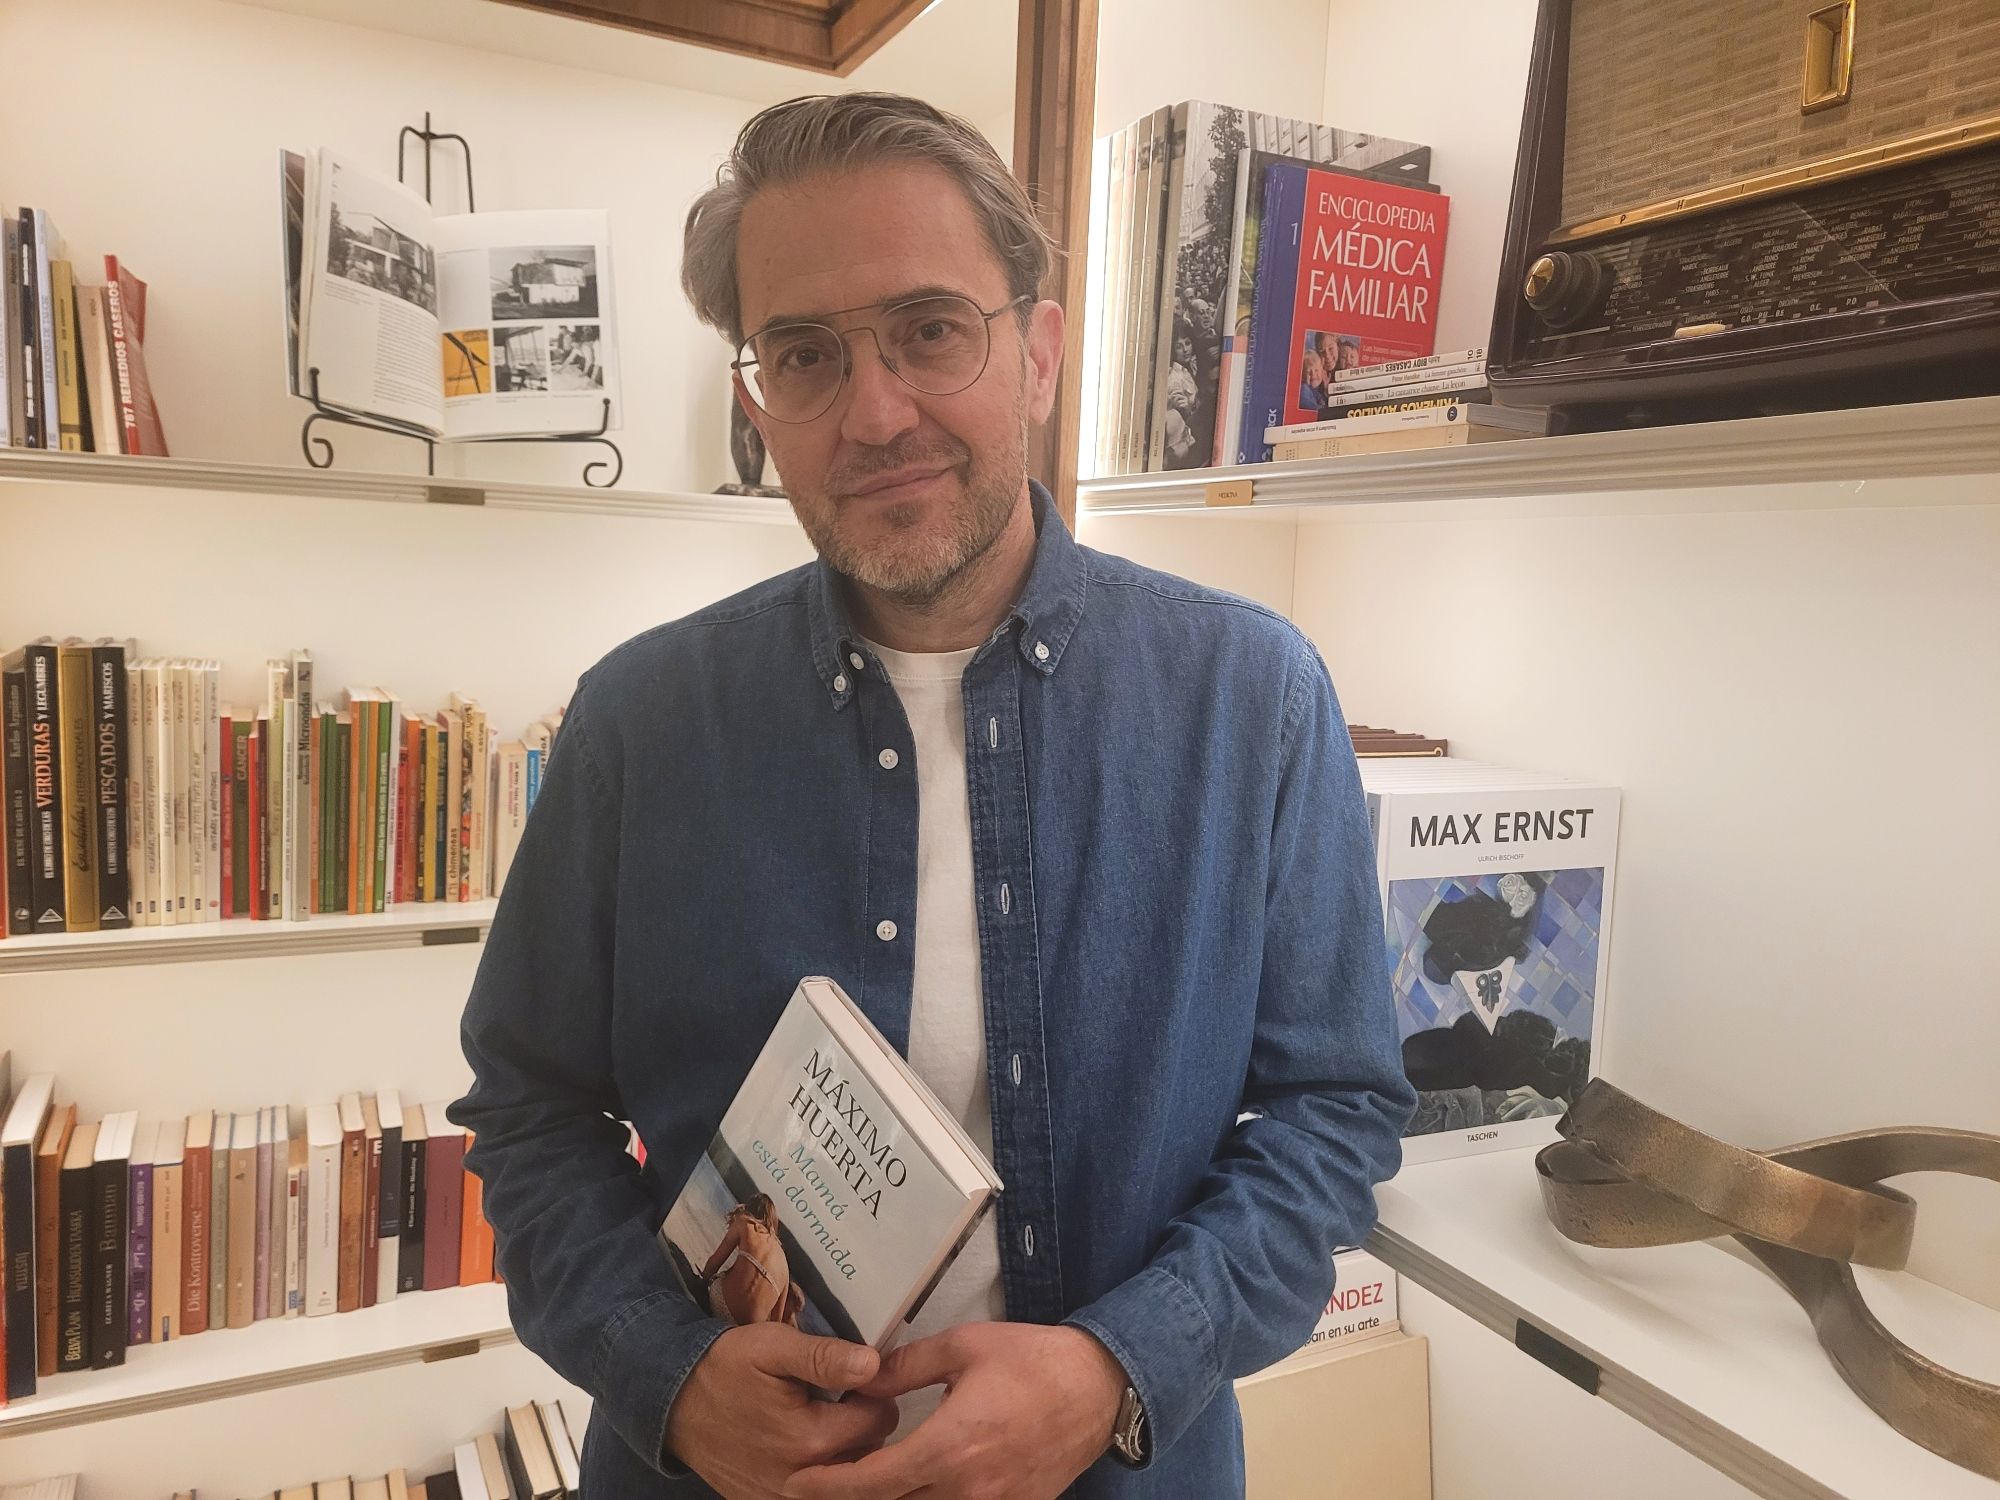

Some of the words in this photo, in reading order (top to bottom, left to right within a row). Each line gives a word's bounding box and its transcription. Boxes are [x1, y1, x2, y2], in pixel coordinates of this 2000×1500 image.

[1291, 222, 1298, 246] 1
[1319, 192, 1436, 234] ENCICLOPEDIA
[1312, 222, 1432, 279] MÉDICA
[107, 281, 125, 338] CASEROS
[1308, 269, 1427, 325] FAMILIAR
[116, 341, 133, 404] REMEDIOS
[1385, 360, 1412, 372] CASARES
[35, 655, 48, 711] LEGUMBRES
[102, 662, 115, 710] MARISCOS
[36, 712, 48, 720] Y
[297, 692, 311, 751] Microondas
[34, 722, 53, 809] VERDURAS
[100, 722, 117, 805] PESCADOS
[1410, 813, 1482, 847] MAX
[1494, 809, 1594, 843] ERNST
[1499, 854, 1524, 862] BISCHOFF
[803, 1048, 907, 1188] MÁXIMO
[1466, 1130, 1498, 1143] TASCHEN
[788, 1083, 882, 1221] HUERTA
[752, 1140, 790, 1184] está
[785, 1186, 857, 1280] dormida
[788, 1144, 849, 1221] Mamá
[100, 1184, 118, 1251] Bauman
[187, 1210, 203, 1284] Kontroverse
[187, 1285, 200, 1312] Die
[1328, 1327, 1341, 1339] en
[1344, 1323, 1355, 1335] su
[1357, 1317, 1380, 1331] arte
